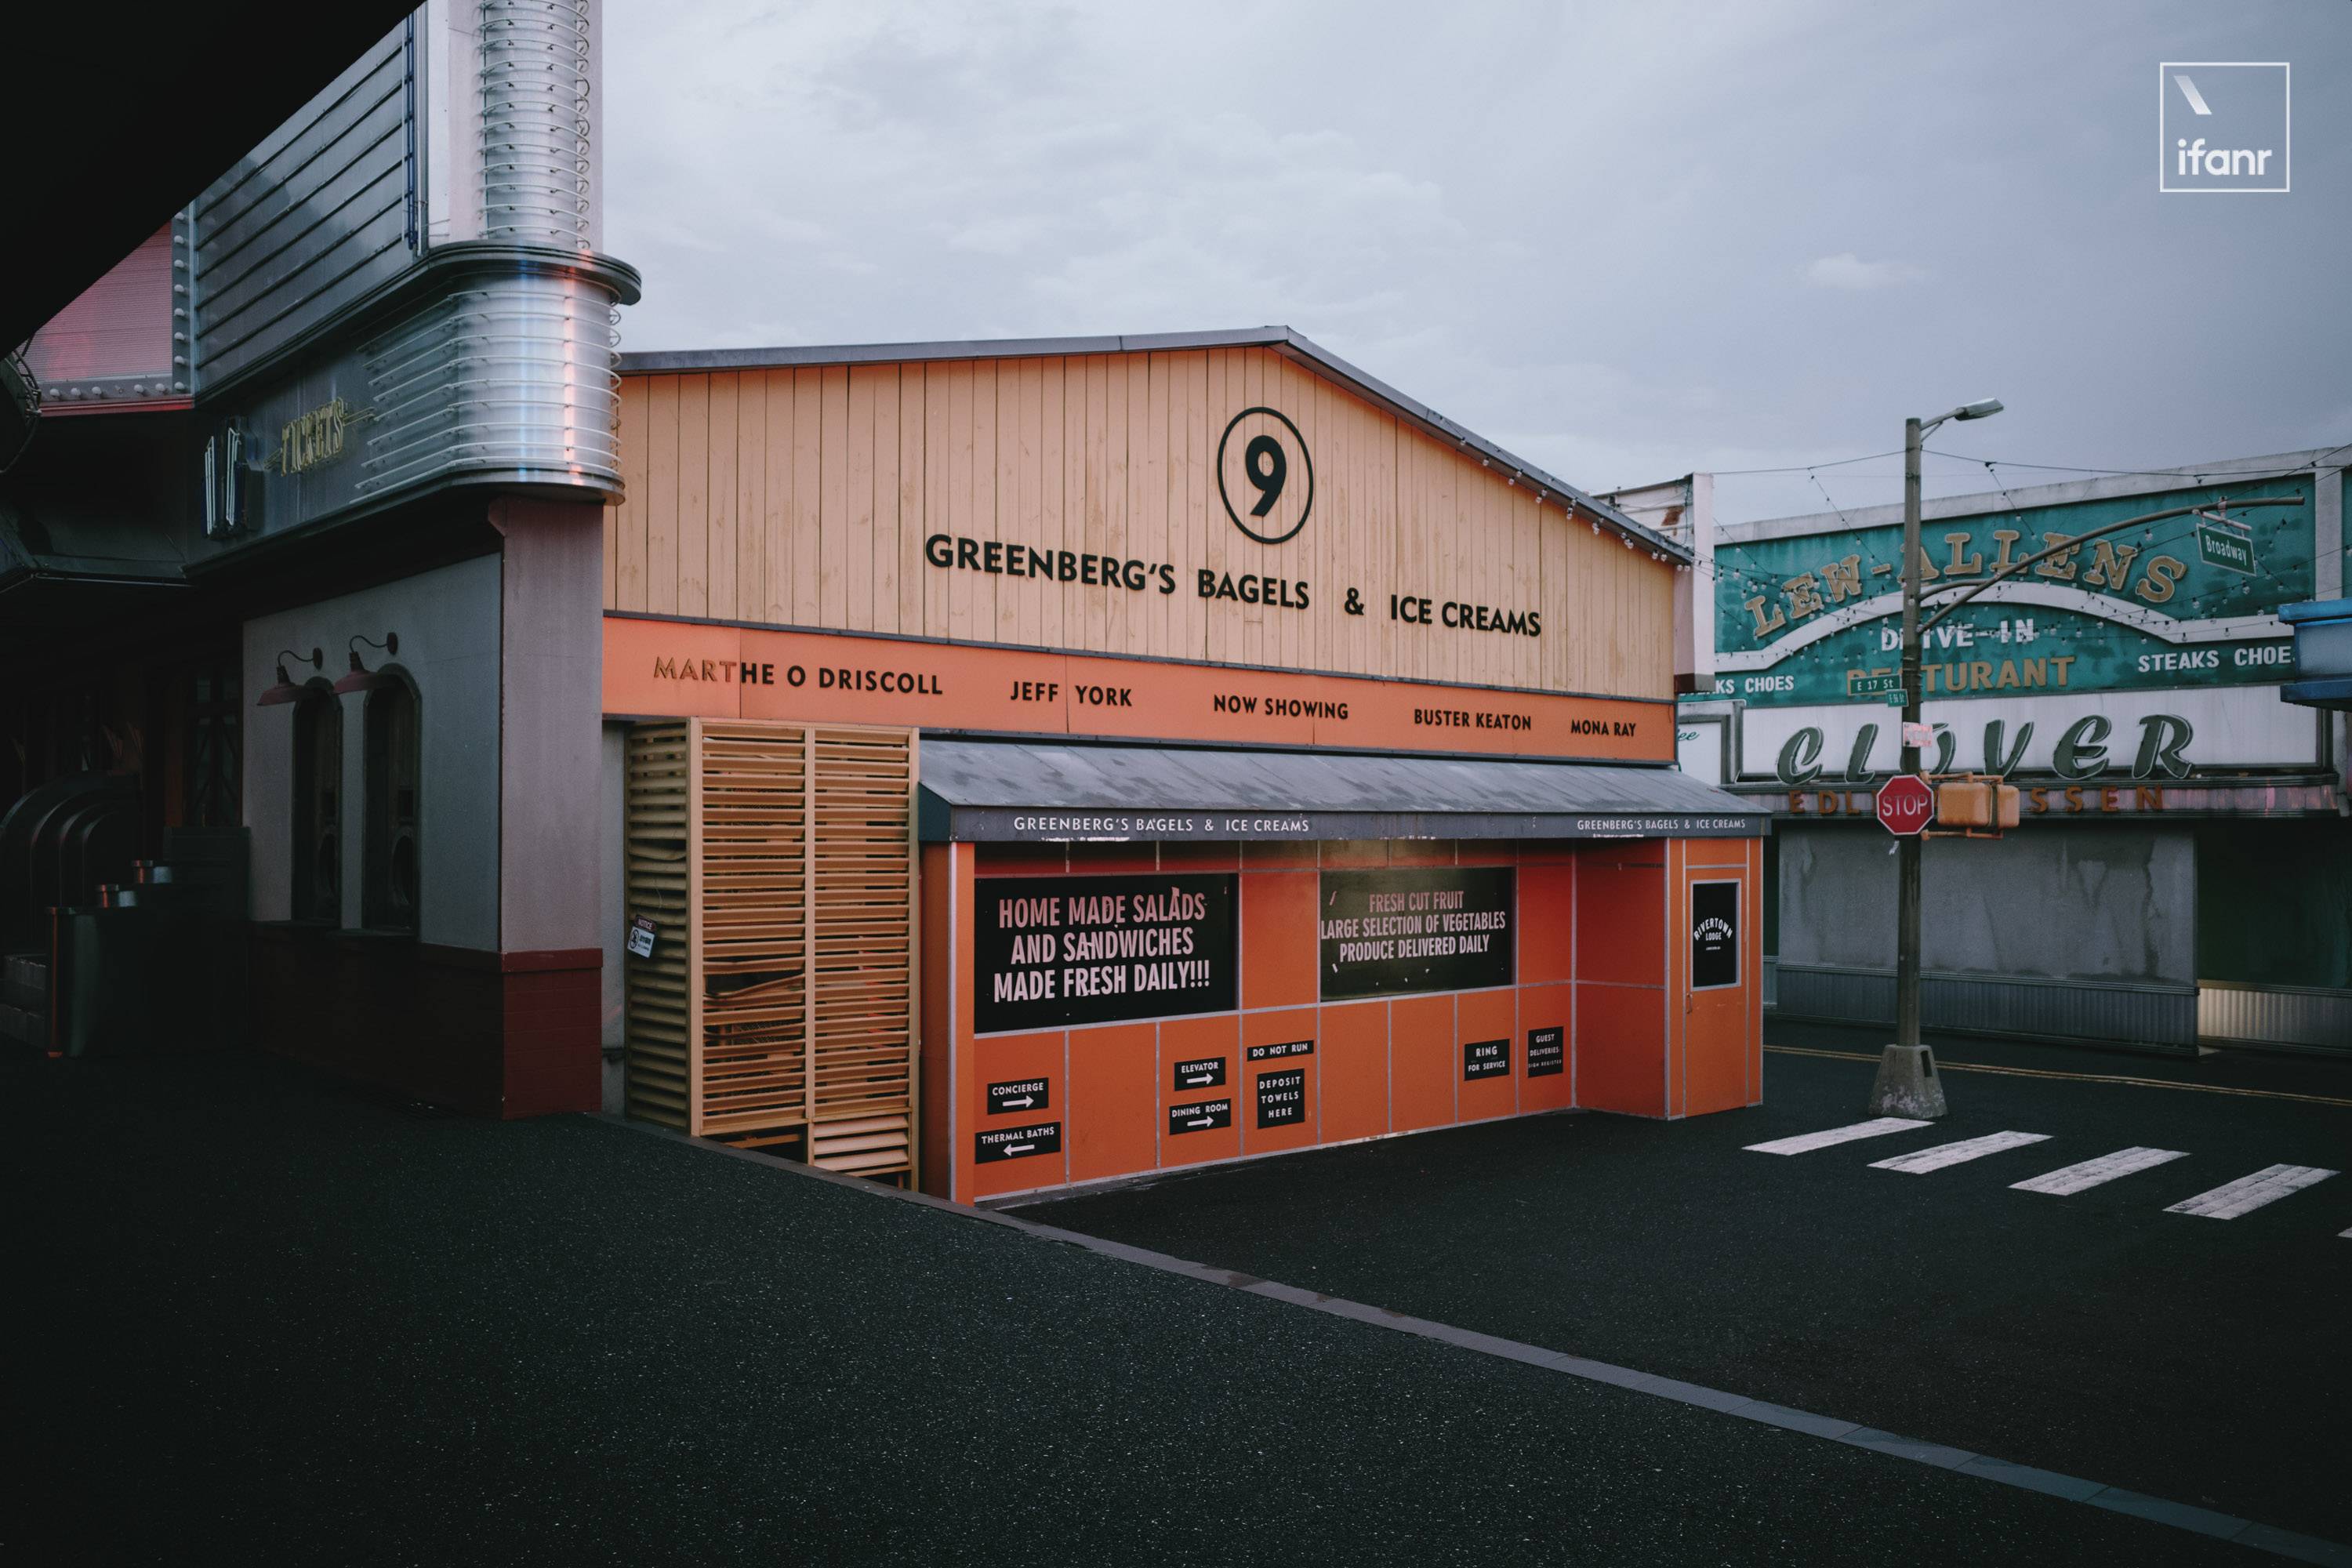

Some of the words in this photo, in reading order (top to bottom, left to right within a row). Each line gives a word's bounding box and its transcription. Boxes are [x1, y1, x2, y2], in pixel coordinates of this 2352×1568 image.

[1245, 435, 1287, 517] 9
[2205, 535, 2247, 566] Broadway
[925, 534, 1176, 594] GREENBERG'S
[1197, 569, 1309, 609] BAGELS
[1344, 587, 1365, 616] &
[1391, 594, 1432, 625] ICE
[1441, 601, 1541, 637] CREAMS
[2138, 649, 2220, 673] STEAKS
[2234, 645, 2296, 666] CHOE
[653, 656, 775, 685] MARTHE
[787, 665, 806, 688] O
[819, 667, 942, 695] DRISCOLL
[1744, 675, 1794, 694] CHOES
[1857, 681, 1862, 691] E
[1867, 680, 1878, 690] 17
[1883, 678, 1894, 688] St
[1011, 681, 1059, 702] JEFF
[1075, 684, 1132, 707] YORK
[1213, 694, 1258, 715] NOW
[1265, 698, 1349, 720] SHOWING
[1414, 709, 1471, 728] BUSTER
[1475, 712, 1532, 731] KEATON
[1570, 719, 1610, 736] MONA
[1613, 722, 1636, 738] RAY
[1882, 793, 1929, 817] STOP
[1014, 816, 1129, 831] GREENBERG'S
[1136, 818, 1193, 832] BAGELS
[1204, 818, 1214, 832] &
[1225, 818, 1248, 832] ICE
[1254, 819, 1309, 833] CREAMS
[1577, 819, 1642, 830] GREENBERG'S
[1646, 819, 1679, 829] BAGELS
[1684, 819, 1690, 829] &
[1697, 819, 1710, 829] ICE
[1713, 818, 1746, 829] CREAMS
[999, 898, 1060, 928] HOME
[1069, 895, 1126, 925] MADE
[1133, 891, 1205, 923] SALADS
[1369, 893, 1405, 913] FRESH
[1409, 892, 1430, 911] CUT
[1433, 891, 1465, 910] FRUIT
[1320, 918, 1359, 939] LARGE
[1363, 915, 1422, 938] SELECTION
[1425, 914, 1439, 934] OF
[1443, 911, 1506, 932] VEGETABLES
[1693, 917, 1733, 941] RIVERTOWN
[1011, 934, 1056, 964] AND
[1063, 927, 1193, 962] SANDWICHES
[1705, 932, 1722, 941] LODGE
[1340, 940, 1394, 963] PRODUCE
[1398, 937, 1456, 959] DELIVERED
[1459, 934, 1490, 954] DAILY
[994, 969, 1055, 1003] MADE
[1063, 965, 1127, 997] FRESH
[1134, 960, 1210, 992] DAILY!!!
[1535, 1034, 1555, 1044] GUEST
[1253, 1048, 1265, 1058] DO
[1269, 1045, 1287, 1054] NOT
[1291, 1043, 1308, 1052] RUN
[1475, 1046, 1497, 1058] RING
[1181, 1062, 1218, 1073] ELEVATOR
[1483, 1060, 1505, 1070] SERVICE
[992, 1083, 1044, 1096] CONCIERGE
[1259, 1076, 1301, 1090] DEPOSIT
[1261, 1091, 1299, 1105] TOWELS
[1171, 1106, 1201, 1118] DINING
[1205, 1103, 1229, 1113] ROOM
[1269, 1107, 1293, 1119] HERE
[981, 1131, 1024, 1145] THERMAL
[1026, 1127, 1054, 1138] BATHS
